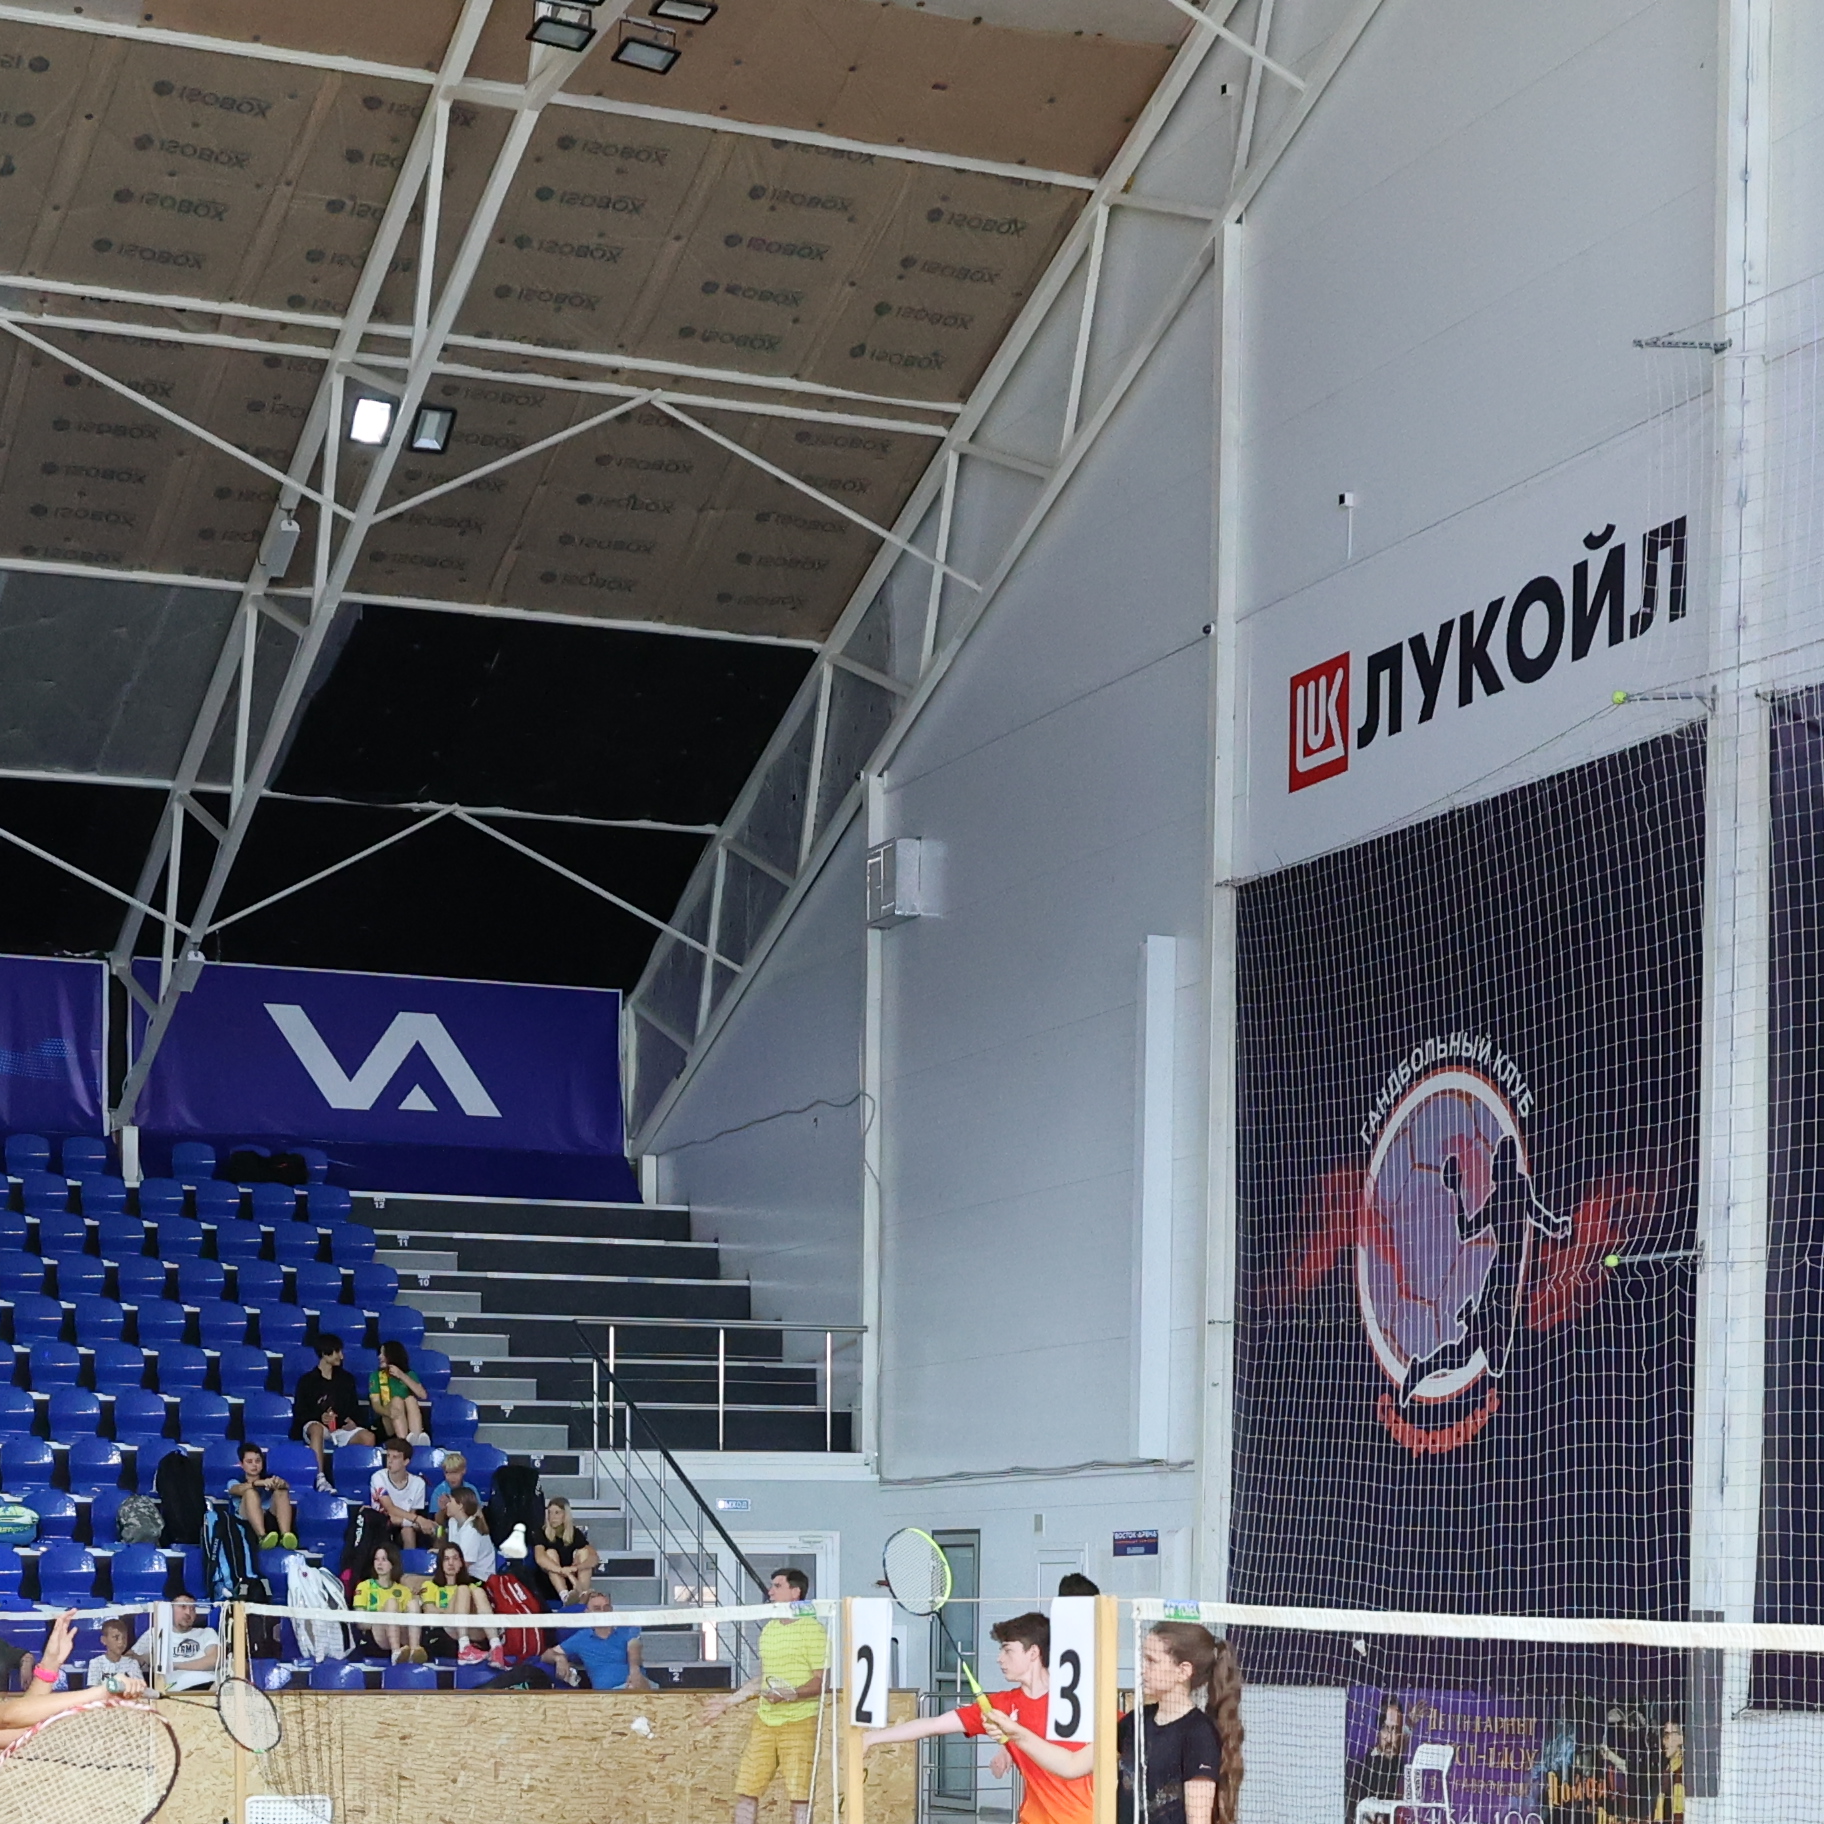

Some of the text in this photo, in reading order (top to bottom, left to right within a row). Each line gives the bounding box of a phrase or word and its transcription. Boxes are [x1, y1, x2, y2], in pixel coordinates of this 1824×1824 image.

[1357, 515, 1688, 750] ЛУКОЙЛ
[1359, 1031, 1536, 1146] ГАНДБОЛЬНЫЙ КЛУБ
[718, 1500, 748, 1510] ЫХОД
[855, 1644, 874, 1725] 2
[1055, 1648, 1082, 1740] 3
